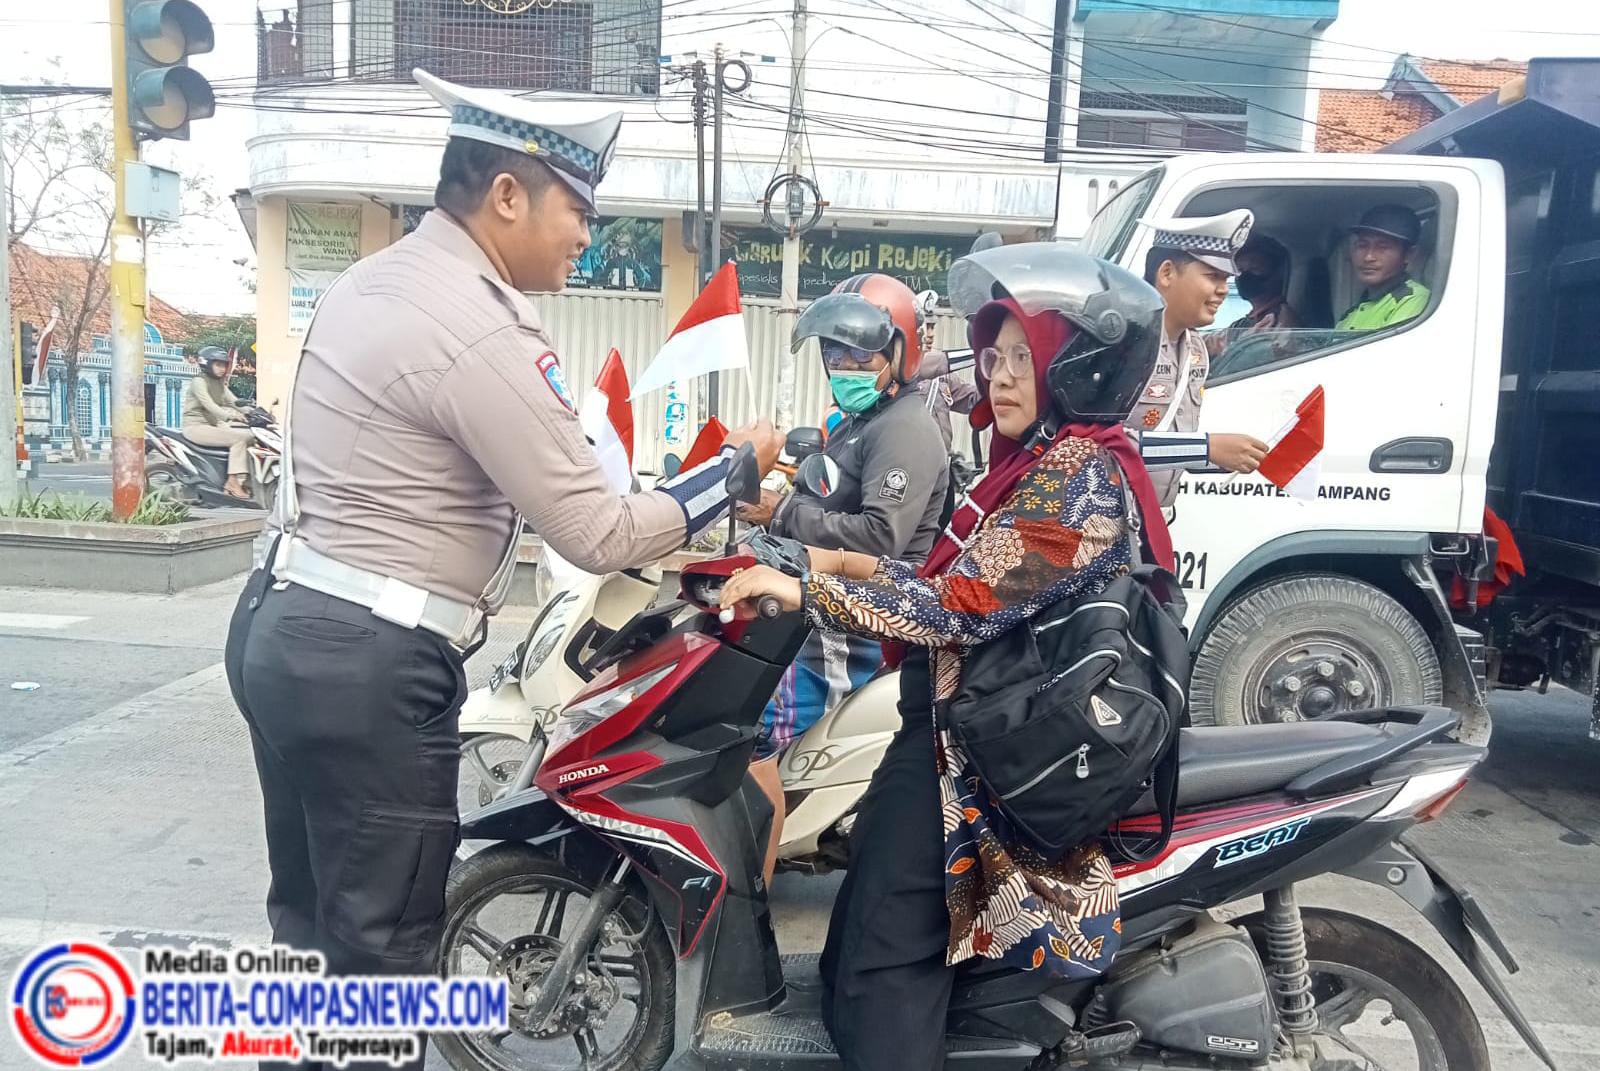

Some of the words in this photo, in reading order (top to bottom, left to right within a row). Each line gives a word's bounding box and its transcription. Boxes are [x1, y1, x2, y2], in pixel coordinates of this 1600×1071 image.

[322, 247, 359, 256] WANITA
[821, 244, 871, 272] Kopi
[1195, 481, 1291, 498] KABUPATE
[1318, 485, 1391, 501] AMPANG
[558, 764, 609, 783] HONDA
[681, 875, 713, 889] FI
